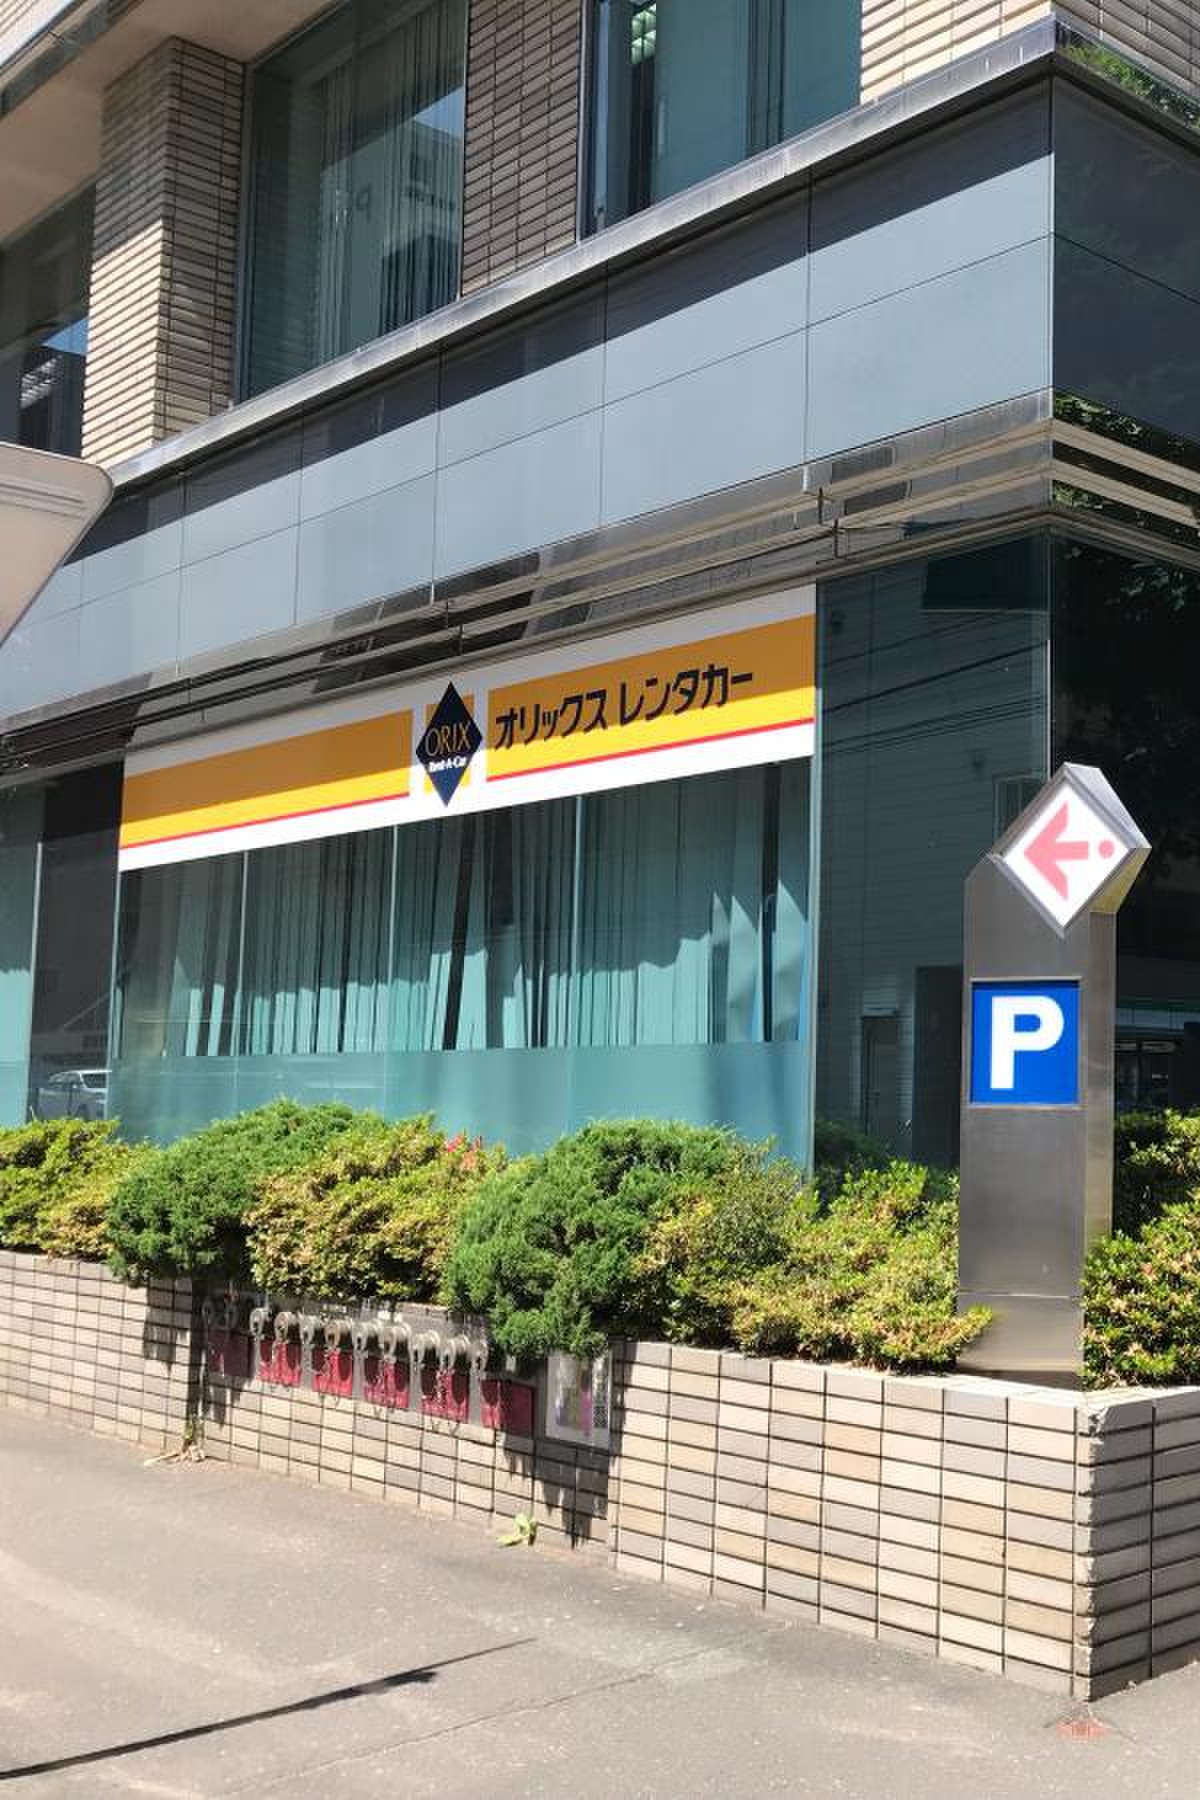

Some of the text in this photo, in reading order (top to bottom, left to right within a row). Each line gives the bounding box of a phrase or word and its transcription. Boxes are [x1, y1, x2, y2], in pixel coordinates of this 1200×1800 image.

[425, 720, 472, 757] ORIX
[494, 664, 752, 750] オリックス レンタカー
[990, 995, 1065, 1089] P
